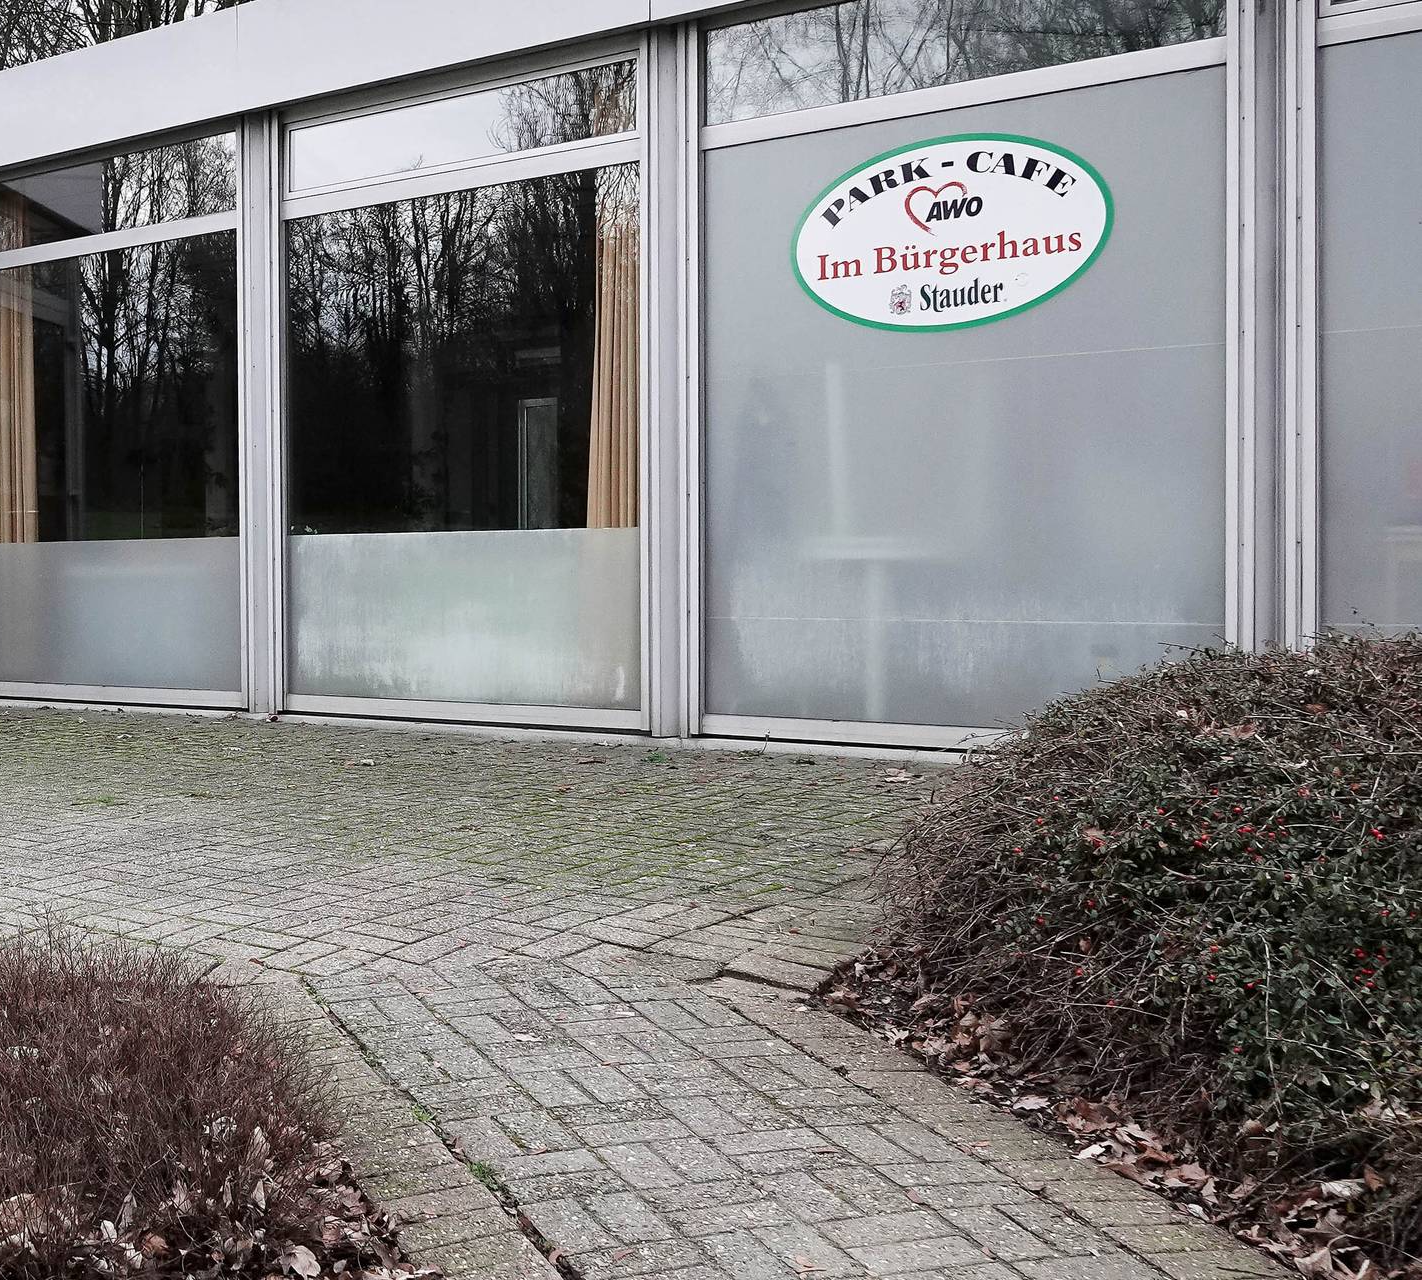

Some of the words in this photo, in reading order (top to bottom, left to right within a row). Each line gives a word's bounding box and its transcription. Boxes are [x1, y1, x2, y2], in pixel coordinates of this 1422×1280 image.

[819, 157, 933, 229] PARK
[966, 150, 1077, 198] CAFE
[925, 196, 983, 223] AWO
[817, 254, 863, 281] Im
[873, 230, 1082, 276] Bürgerhaus
[919, 278, 1004, 313] Stauder
